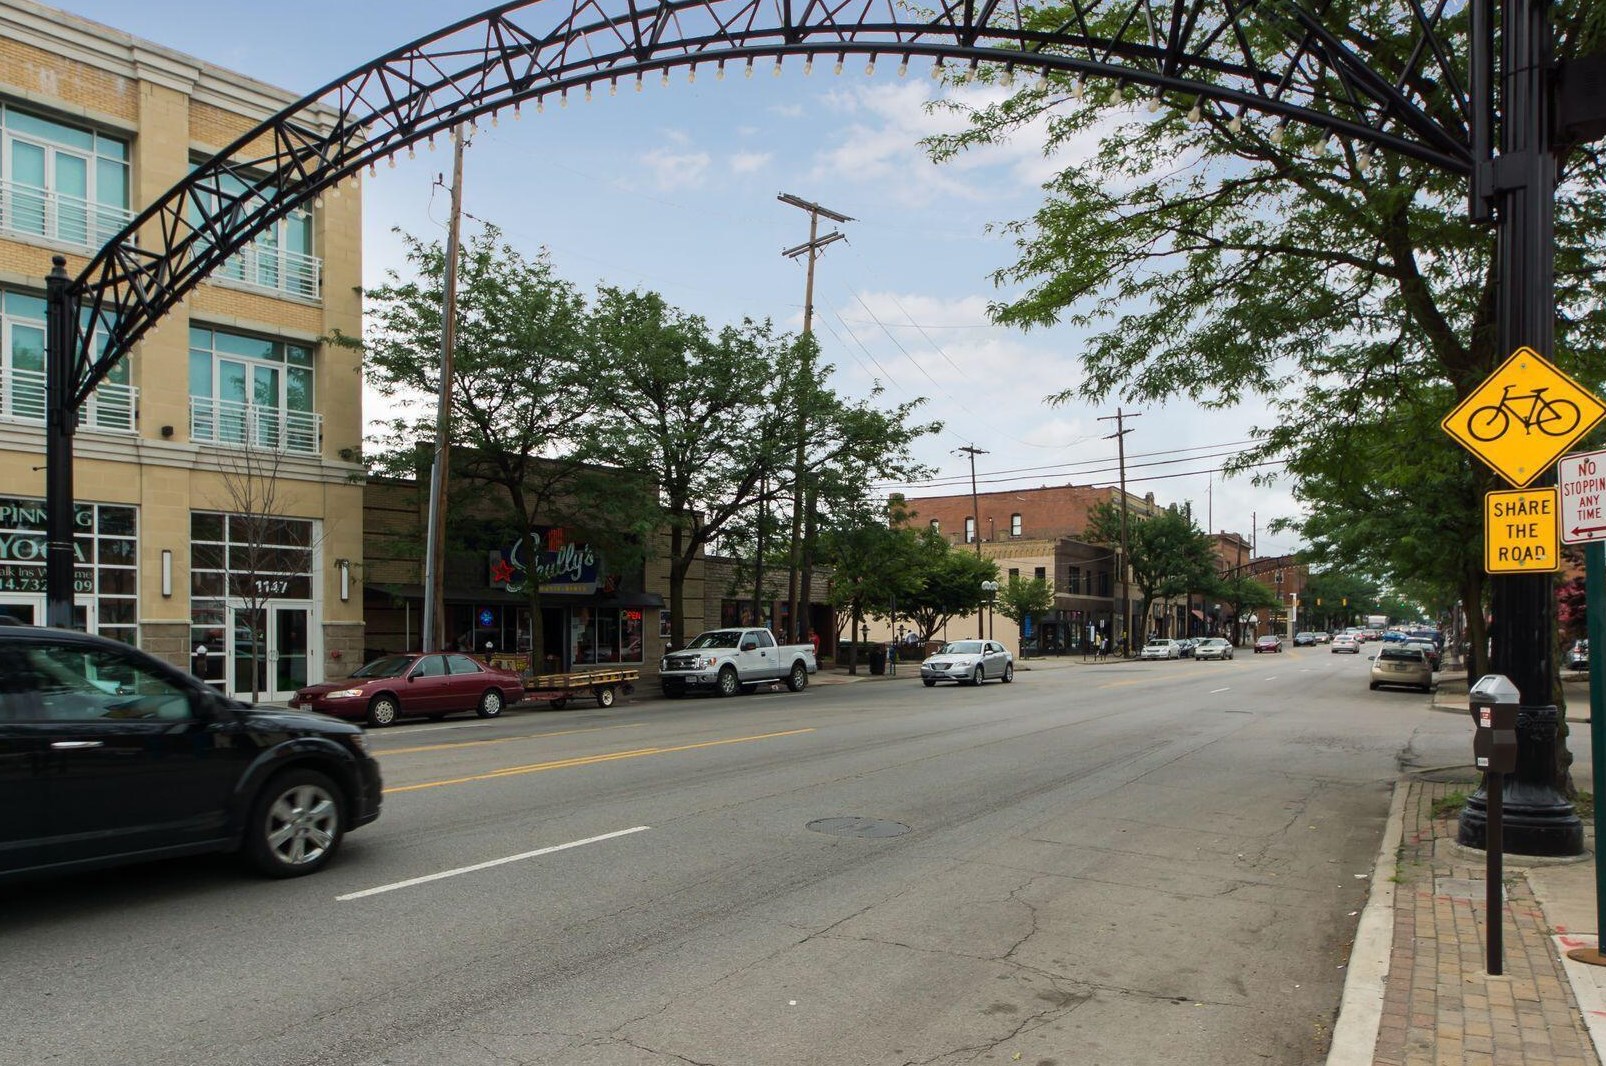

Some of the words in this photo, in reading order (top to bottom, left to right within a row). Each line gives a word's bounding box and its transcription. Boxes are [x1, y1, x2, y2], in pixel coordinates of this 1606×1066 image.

[1579, 461, 1596, 477] NO
[1493, 499, 1551, 518] SHARE
[1579, 494, 1600, 508] ANY
[0, 506, 92, 527] PINNG
[1577, 507, 1602, 521] TIME
[1506, 523, 1539, 540] THE
[0, 534, 86, 562] YOA
[1499, 545, 1546, 562] ROAD
[18, 567, 34, 577] Ins
[255, 580, 288, 594] 1147
[619, 608, 641, 621] OPEN
